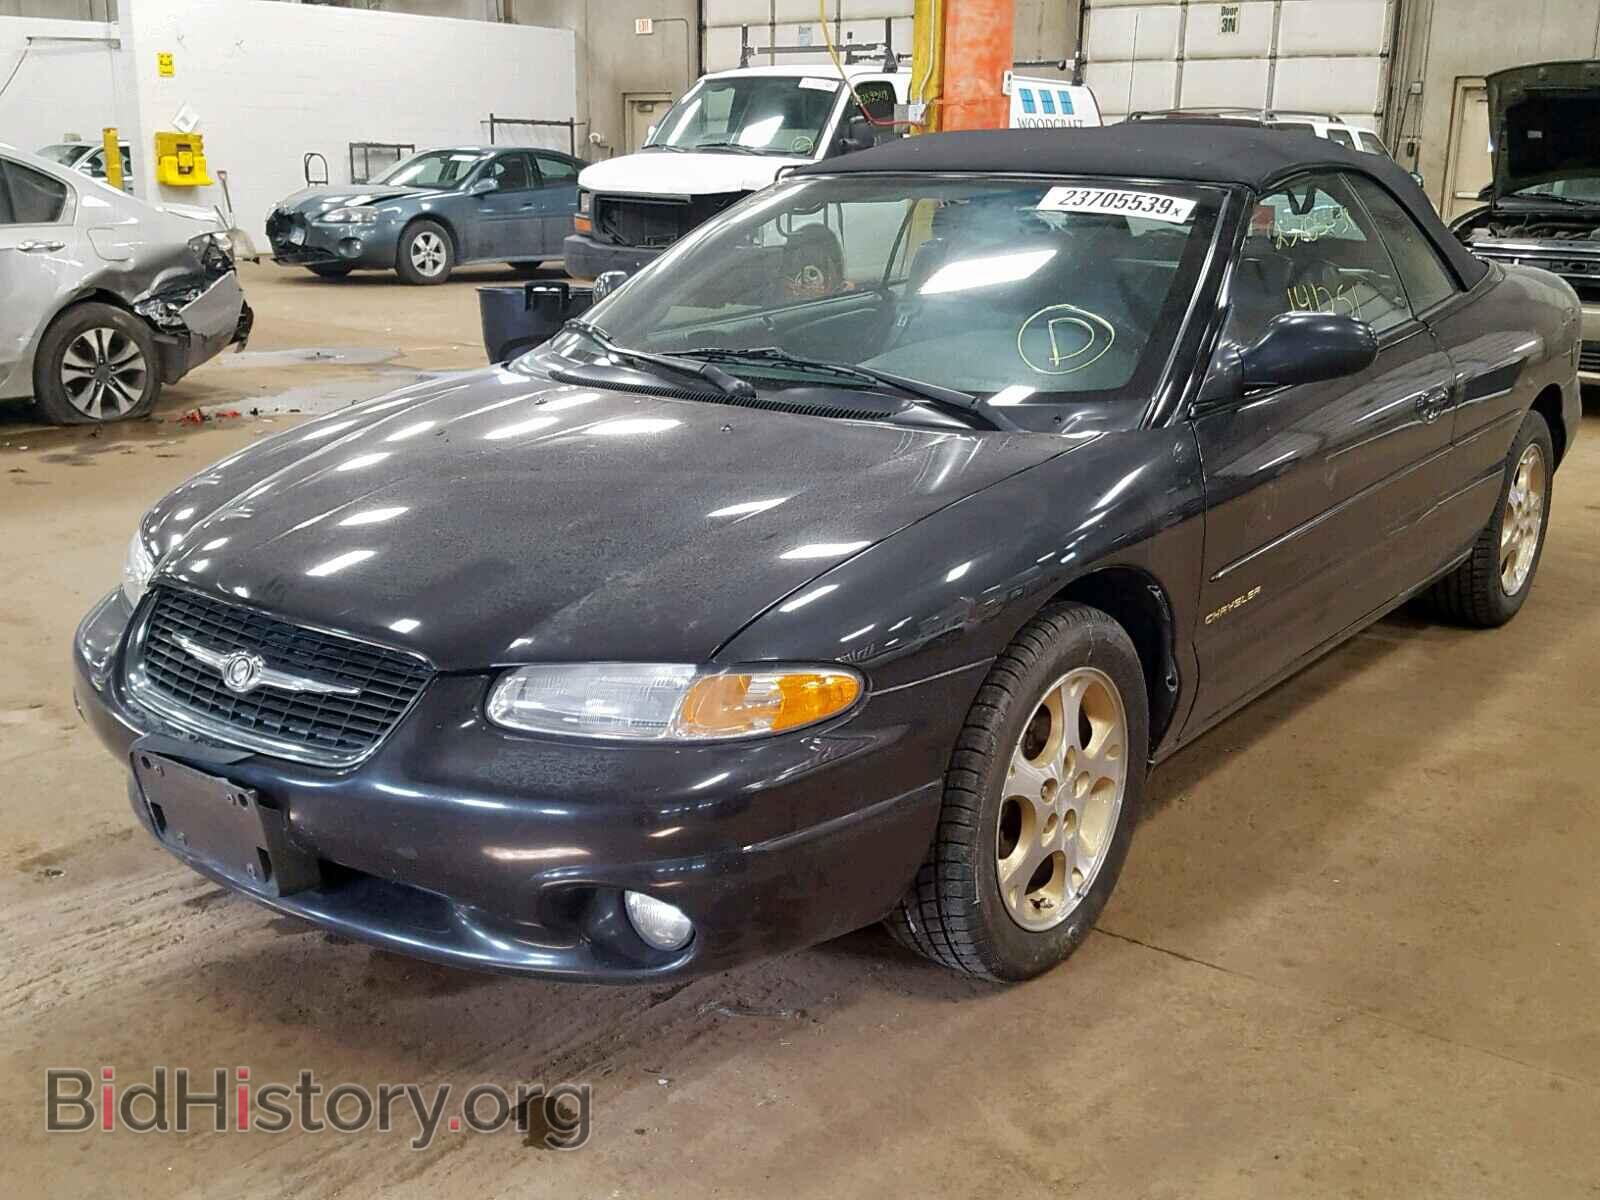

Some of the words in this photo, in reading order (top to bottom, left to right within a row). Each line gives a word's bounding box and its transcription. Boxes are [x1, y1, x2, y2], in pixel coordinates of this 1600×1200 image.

[1221, 6, 1239, 16] Door
[1221, 18, 1236, 32] 3N
[1047, 317, 1095, 367] D
[1205, 586, 1262, 625] CHRYSLER
